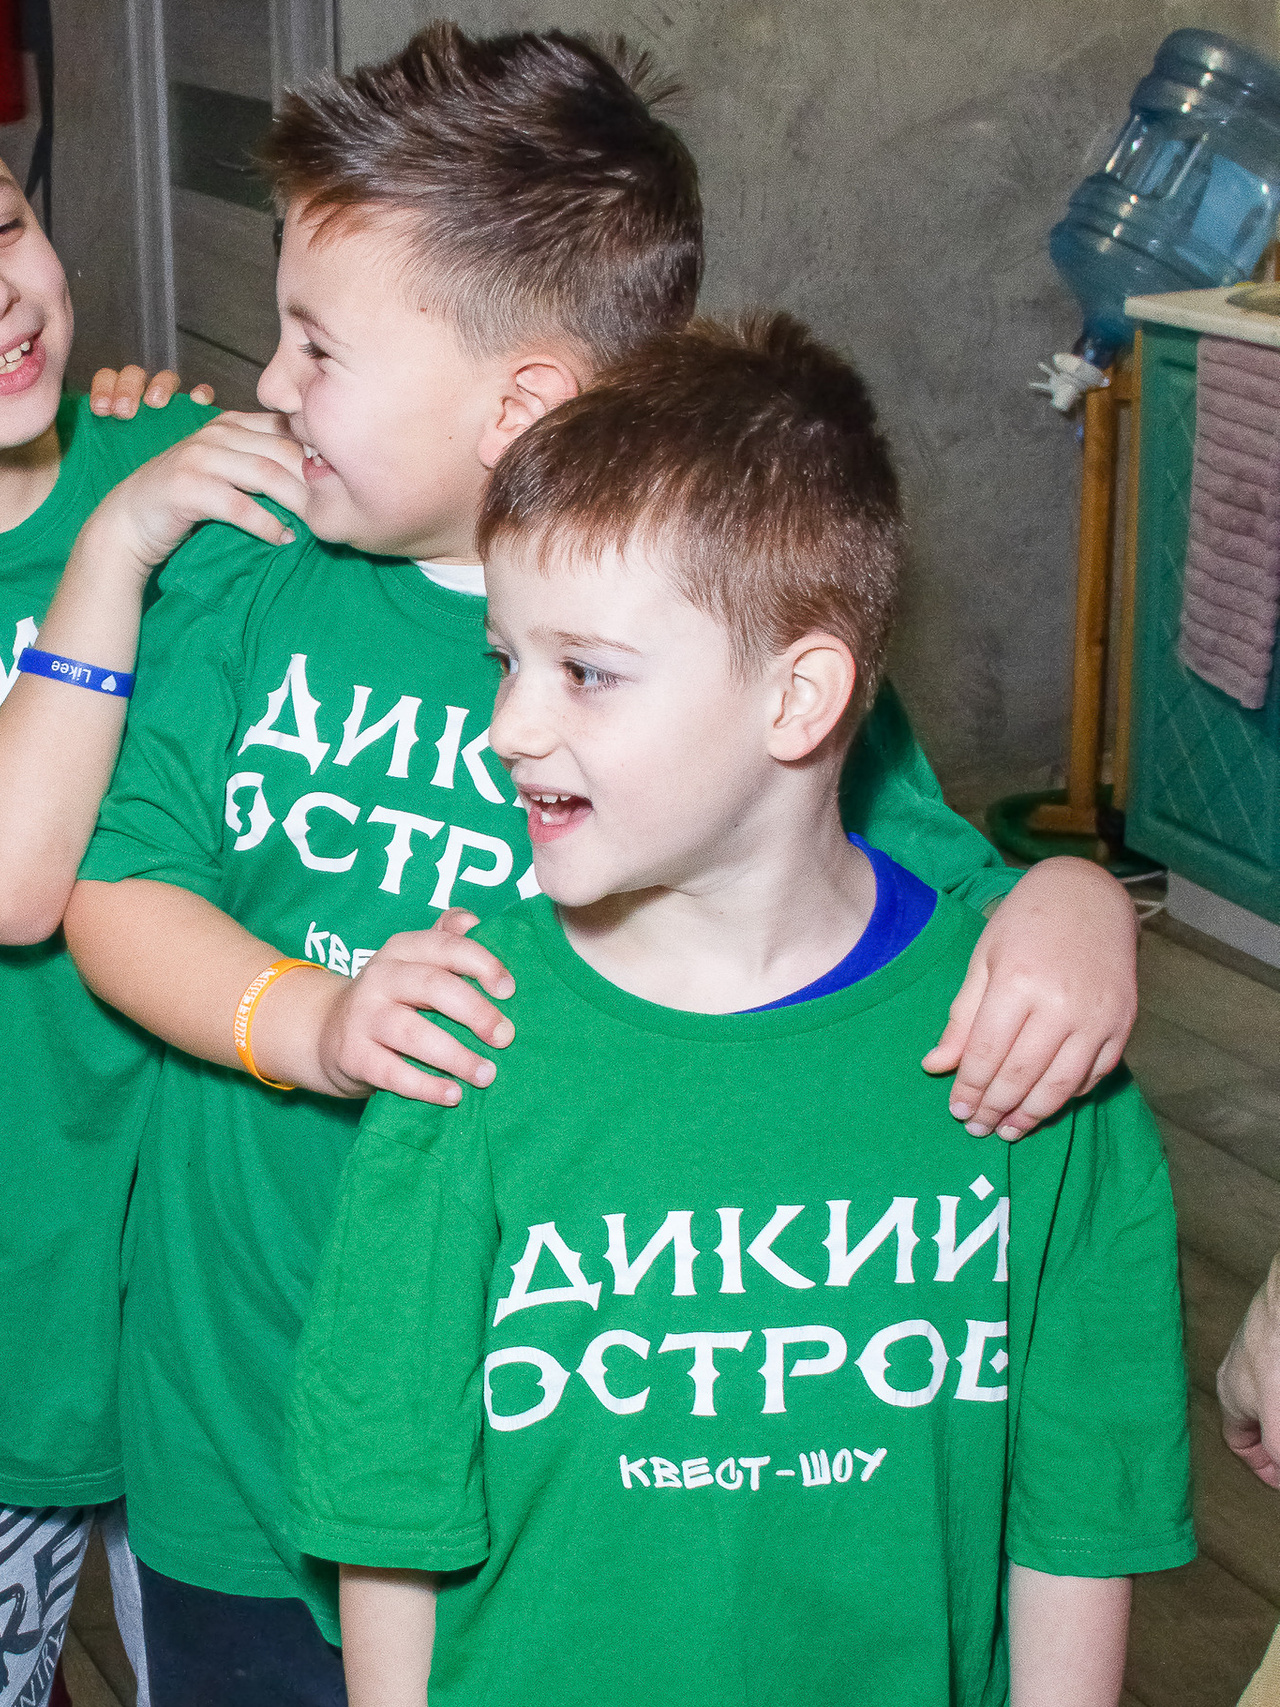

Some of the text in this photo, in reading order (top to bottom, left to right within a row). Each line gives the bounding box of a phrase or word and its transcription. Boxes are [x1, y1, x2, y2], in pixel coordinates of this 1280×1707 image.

[51, 660, 92, 684] Likee
[237, 653, 531, 808] ДИК
[225, 771, 542, 910] ОСТР
[493, 1174, 1010, 1328] ДИКИЙ
[483, 1319, 1009, 1432] ОСТРОВ
[619, 1447, 888, 1492] КВЕСТ-ШОУ
